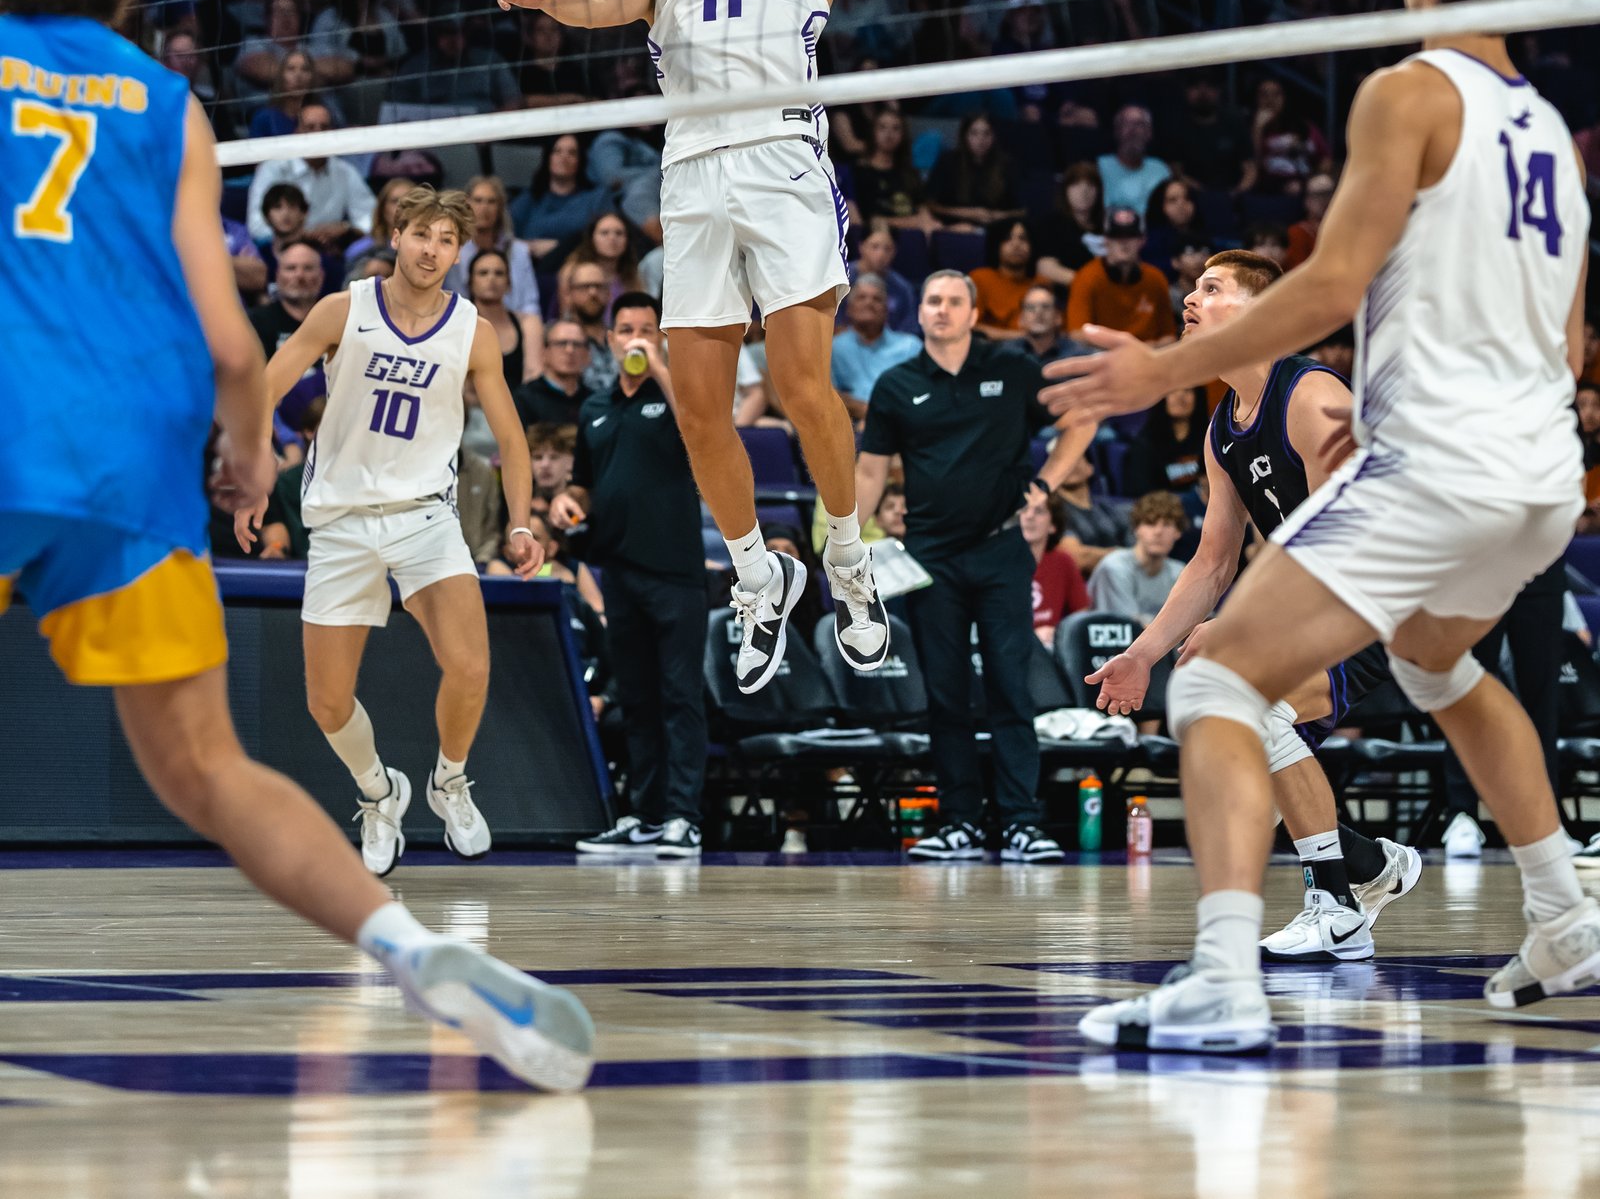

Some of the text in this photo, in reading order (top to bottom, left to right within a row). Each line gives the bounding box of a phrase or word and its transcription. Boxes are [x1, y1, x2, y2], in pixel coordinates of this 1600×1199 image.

[11, 98, 97, 244] 7
[1498, 128, 1564, 258] 14
[364, 351, 441, 389] GCU
[369, 388, 421, 441] 10
[1088, 623, 1133, 648] GCU
